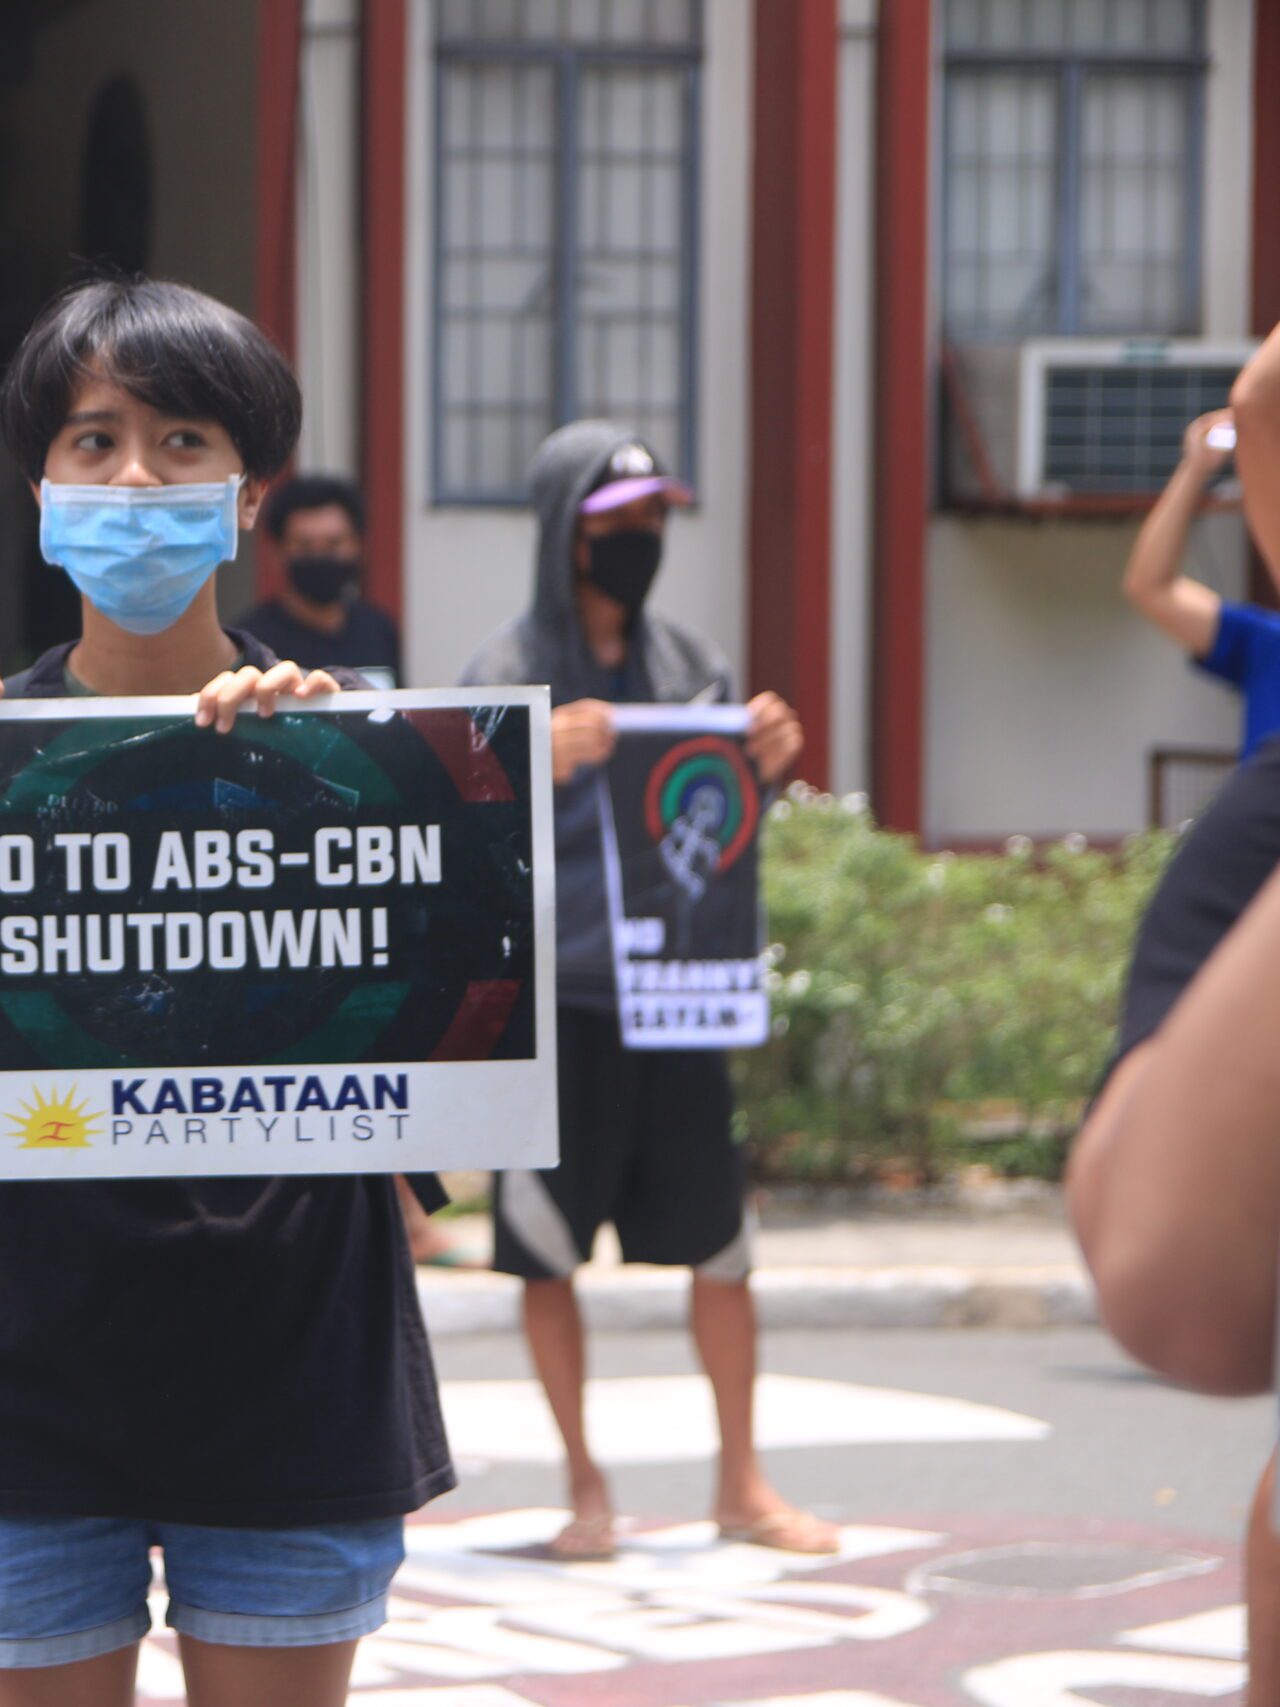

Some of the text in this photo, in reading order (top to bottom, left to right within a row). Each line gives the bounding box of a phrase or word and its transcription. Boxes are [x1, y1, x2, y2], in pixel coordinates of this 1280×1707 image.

[54, 832, 131, 892] TO
[151, 824, 442, 891] ABS-CBN
[0, 907, 389, 974] SHUTDOWN!
[111, 1073, 410, 1116] KABATAAN
[112, 1113, 412, 1145] PARTYLIST
